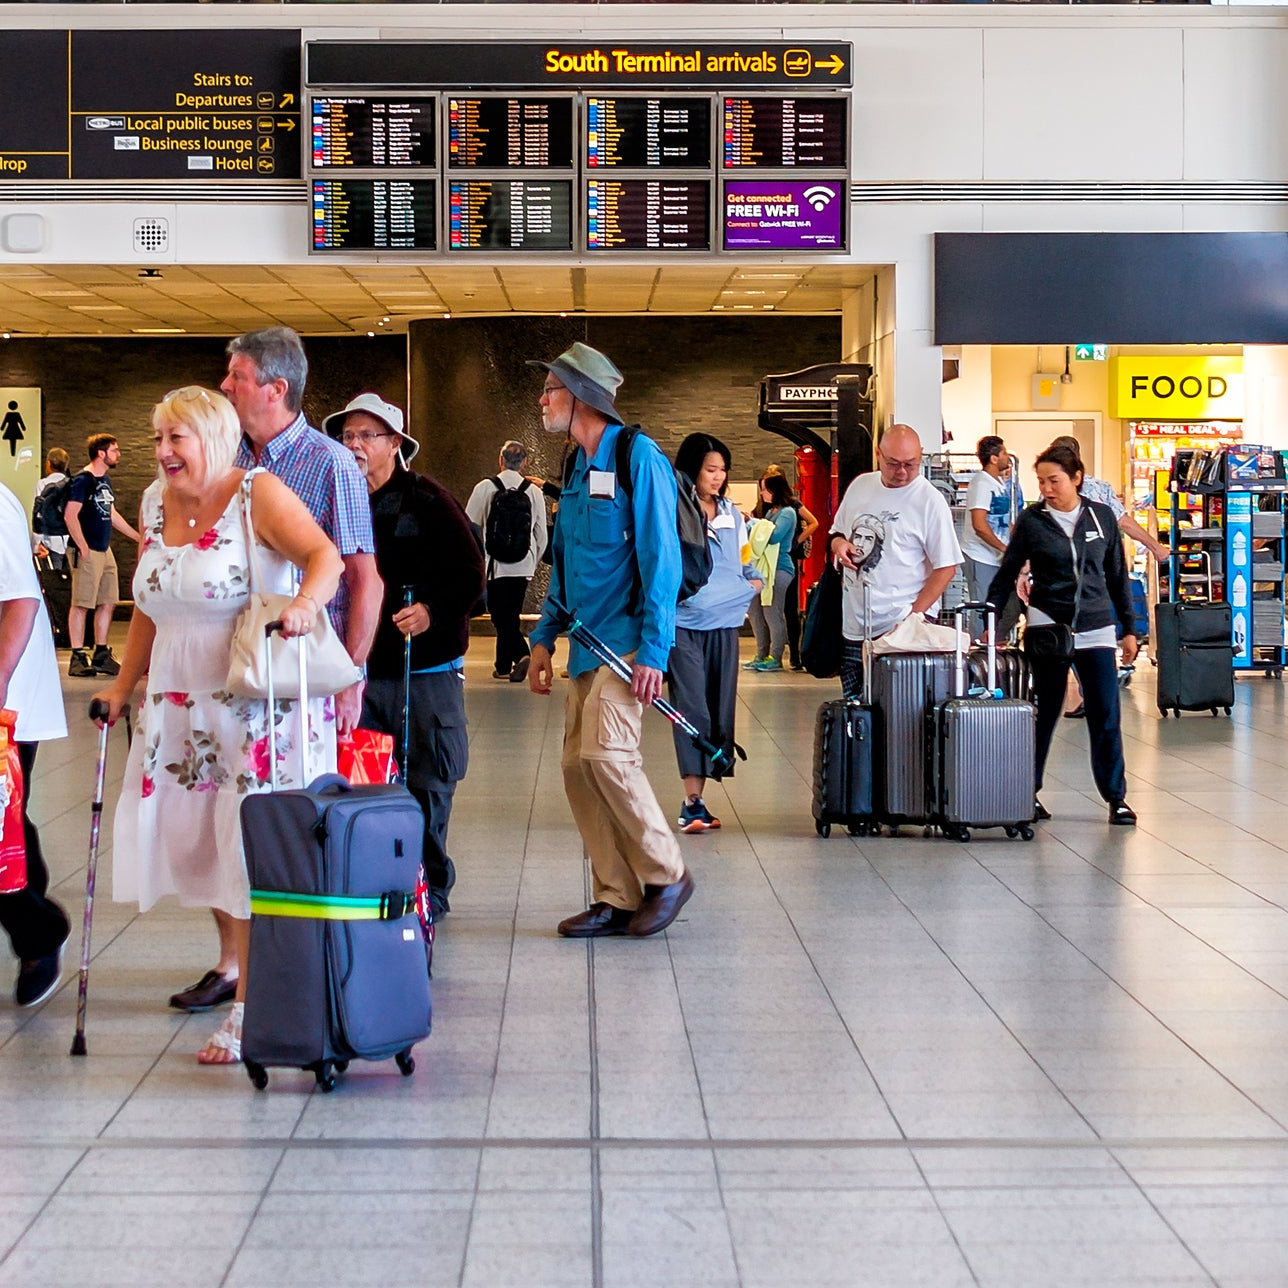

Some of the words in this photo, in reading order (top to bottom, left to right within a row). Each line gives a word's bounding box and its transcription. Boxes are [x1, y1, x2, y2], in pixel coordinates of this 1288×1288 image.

[545, 50, 609, 73] South
[612, 50, 701, 73] Terminal
[706, 51, 777, 73] arrivals
[193, 73, 232, 87] Stairs
[234, 75, 254, 87] to:
[175, 93, 253, 109] Departures
[127, 117, 163, 131] Local
[167, 117, 209, 133] public
[213, 117, 253, 131] buses
[142, 137, 201, 150] Business
[204, 136, 253, 153] lounge
[216, 157, 253, 170] Hotel
[727, 193, 741, 203] Get
[746, 193, 792, 203] connected
[726, 204, 762, 217] FREE
[1130, 375, 1228, 399] FOOD
[1159, 425, 1187, 434] MEAL
[1188, 425, 1215, 434] DEAL
